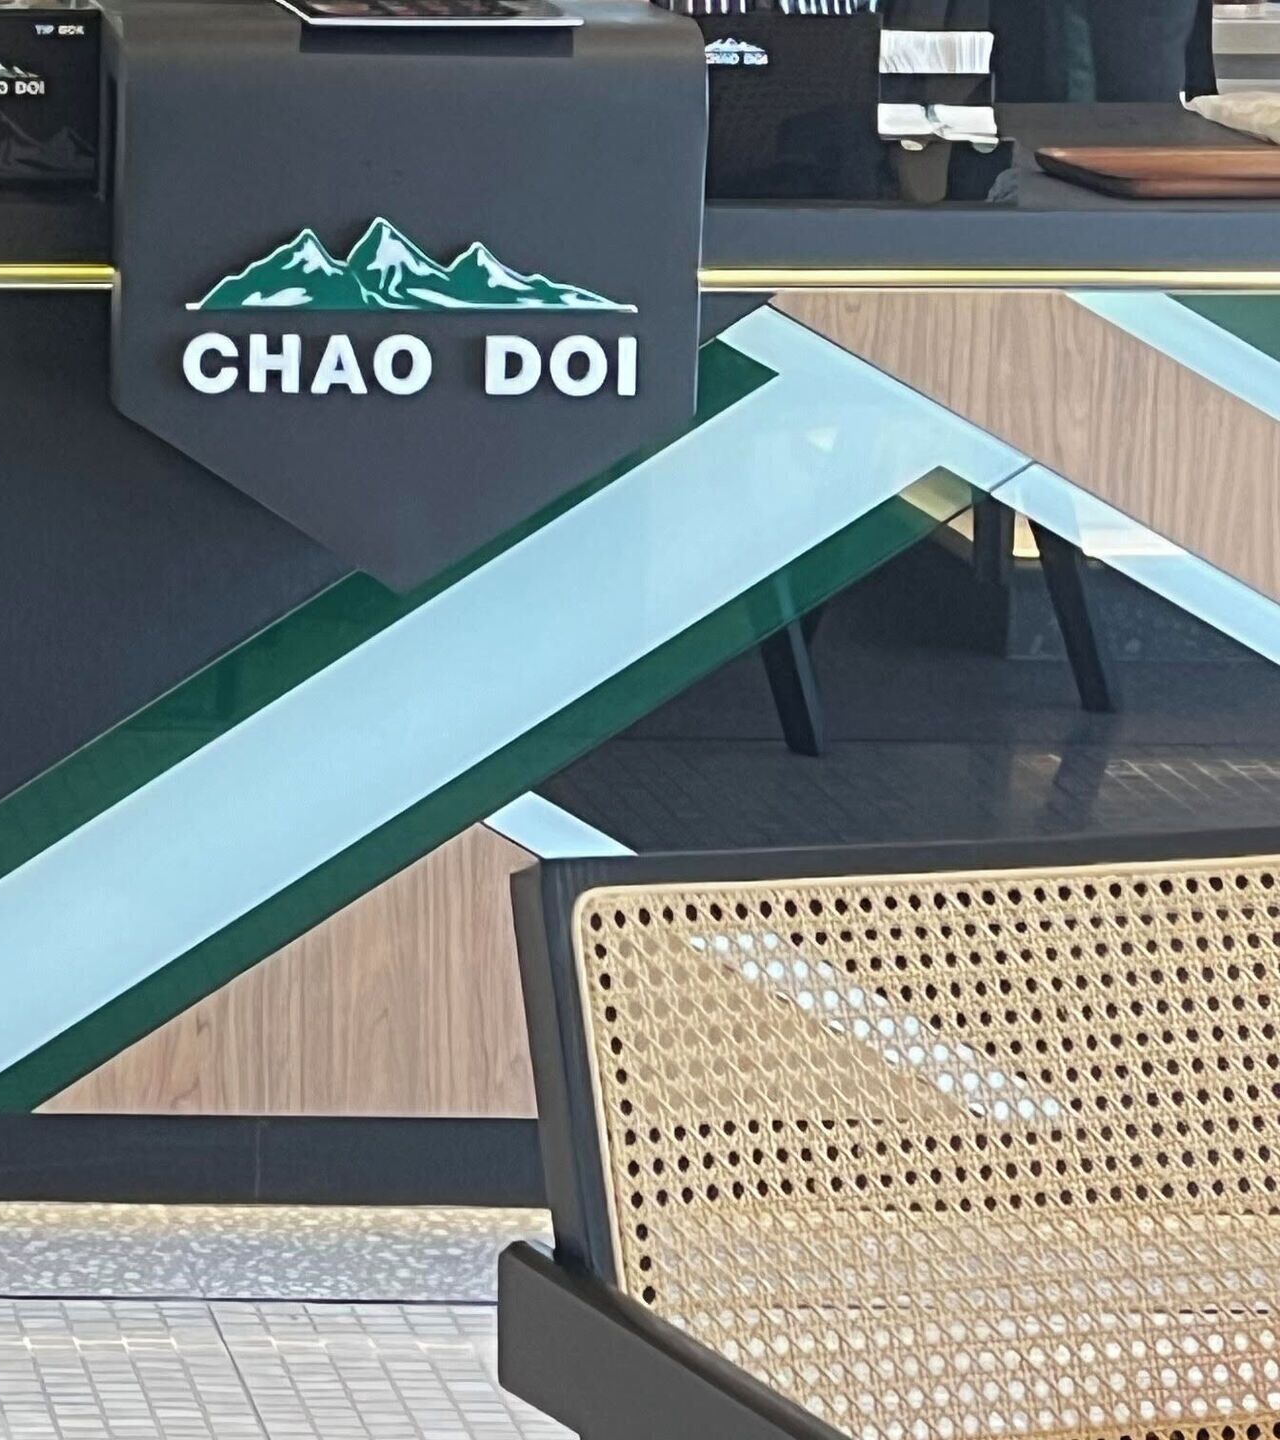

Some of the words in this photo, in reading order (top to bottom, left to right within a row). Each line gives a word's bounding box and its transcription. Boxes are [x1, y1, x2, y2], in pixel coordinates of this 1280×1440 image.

[15, 81, 46, 95] DOI
[182, 331, 433, 396] CHAO
[484, 333, 638, 397] DOI
